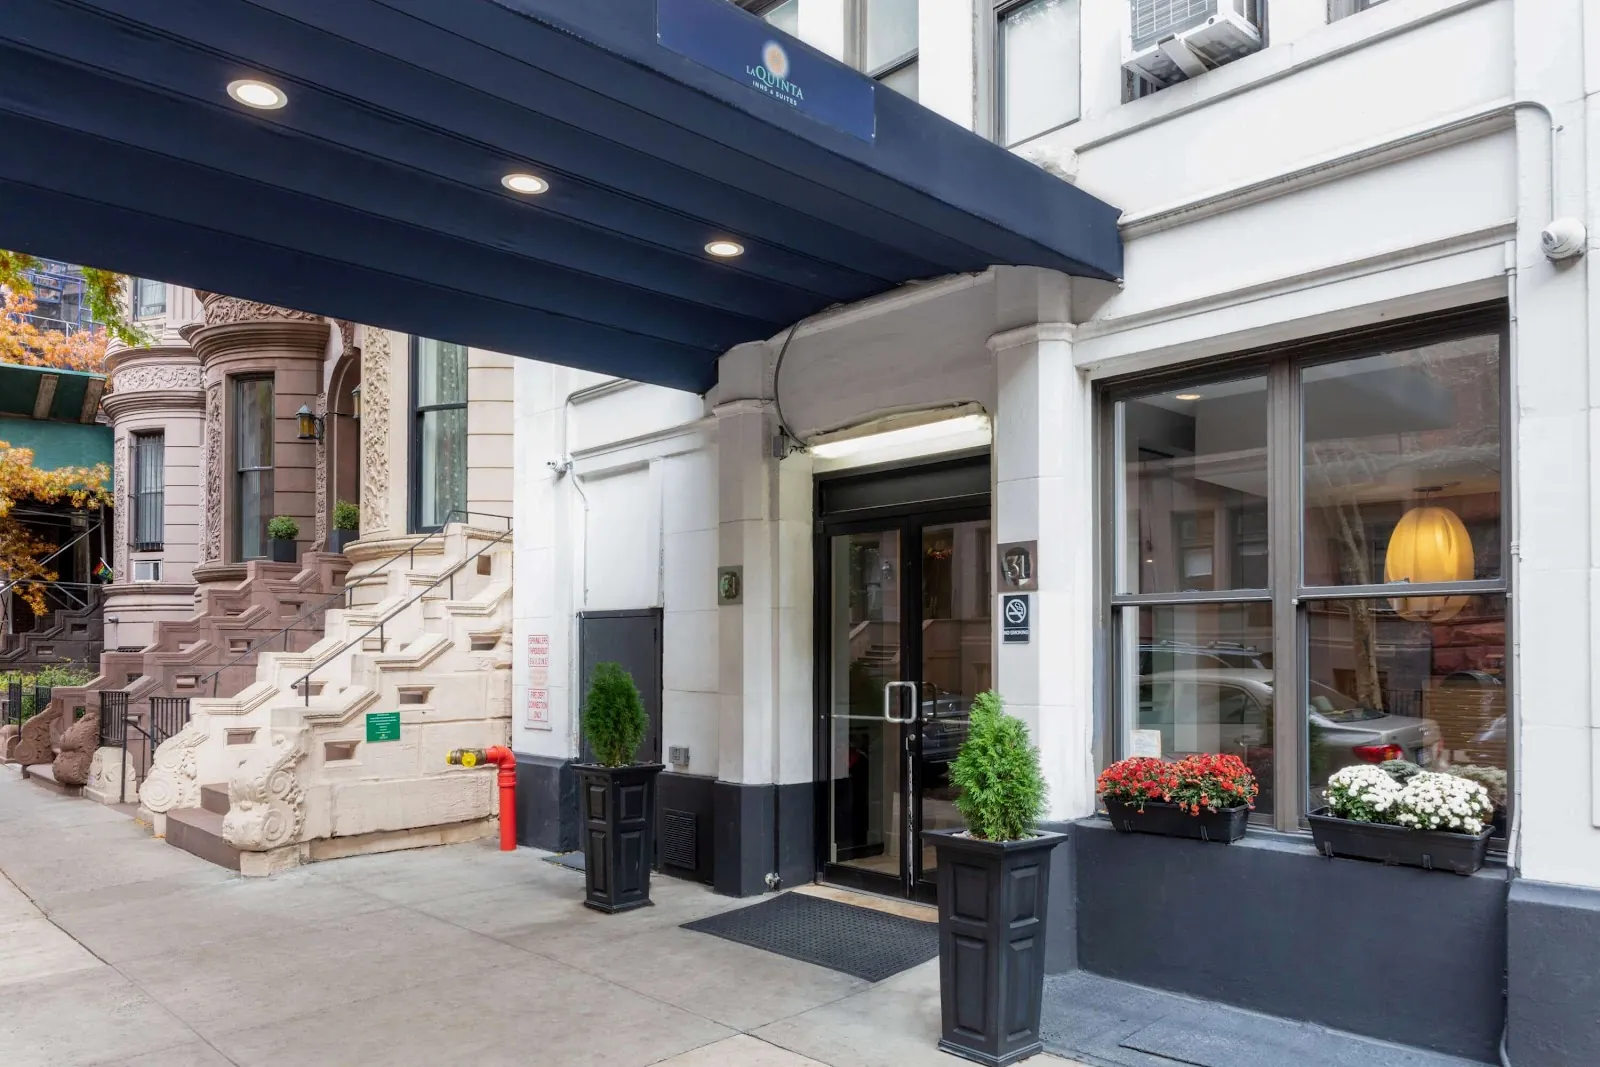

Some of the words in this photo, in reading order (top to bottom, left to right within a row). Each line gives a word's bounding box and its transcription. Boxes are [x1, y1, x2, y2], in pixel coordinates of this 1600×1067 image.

[746, 65, 756, 77] LA
[755, 65, 804, 100] QUINTA
[752, 80, 768, 92] INNS
[775, 91, 798, 106] SUITES
[1006, 555, 1026, 578] 31
